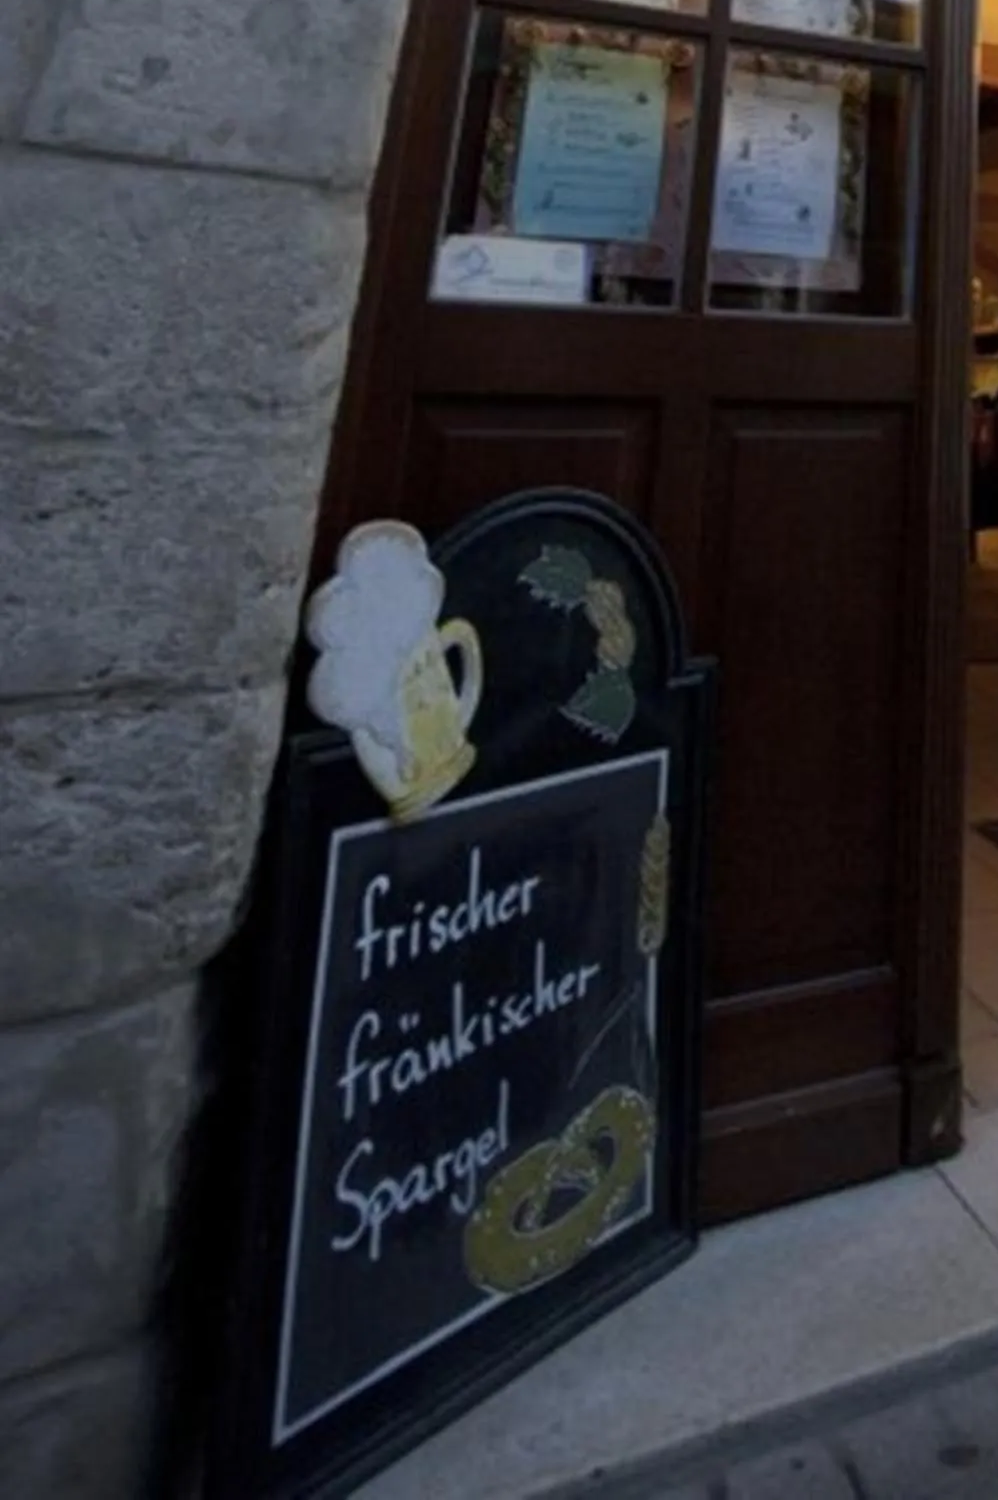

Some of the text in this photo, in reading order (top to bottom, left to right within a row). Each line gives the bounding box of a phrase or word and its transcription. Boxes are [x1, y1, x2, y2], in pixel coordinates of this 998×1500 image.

[355, 846, 541, 982] frischer
[337, 938, 600, 1122] fränkischer
[330, 1077, 509, 1262] Spargel
